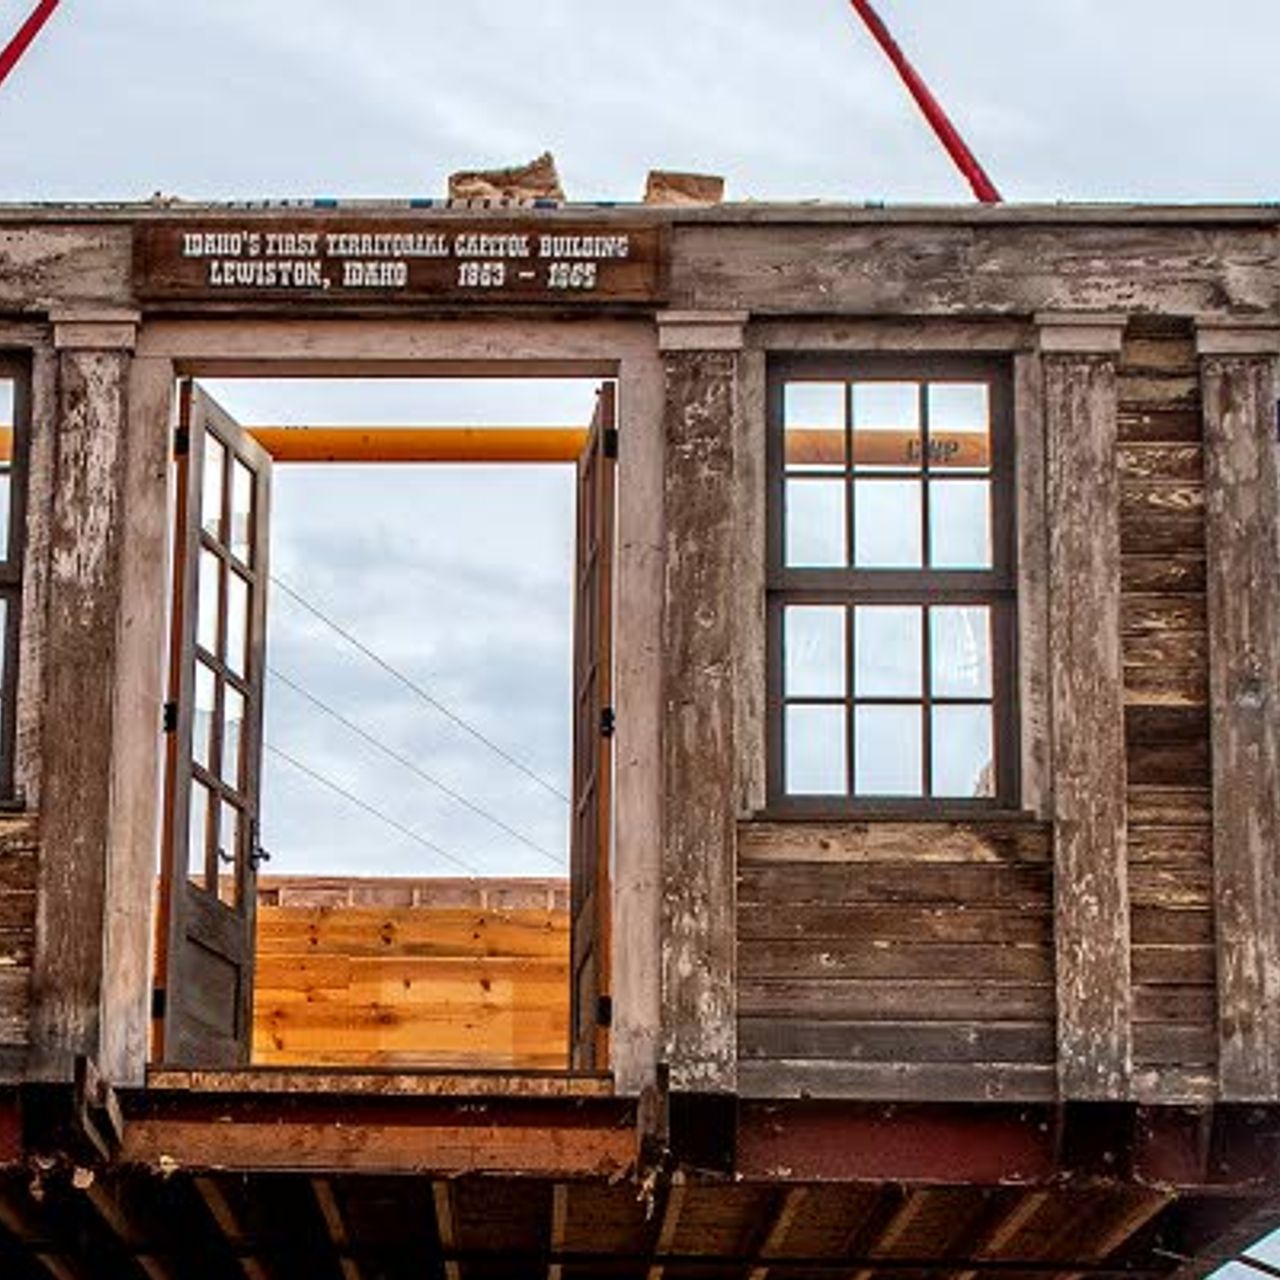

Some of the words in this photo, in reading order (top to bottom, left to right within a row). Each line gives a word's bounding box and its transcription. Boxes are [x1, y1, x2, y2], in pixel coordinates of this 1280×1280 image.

[183, 231, 260, 256] IDAHO'S
[325, 233, 449, 257] TERRITORIAL
[454, 234, 530, 257] CAPITOL
[537, 235, 629, 258] BUILDING
[210, 260, 331, 290] LEWISTON,
[342, 261, 408, 287] IDAHO
[457, 262, 505, 287] 1863
